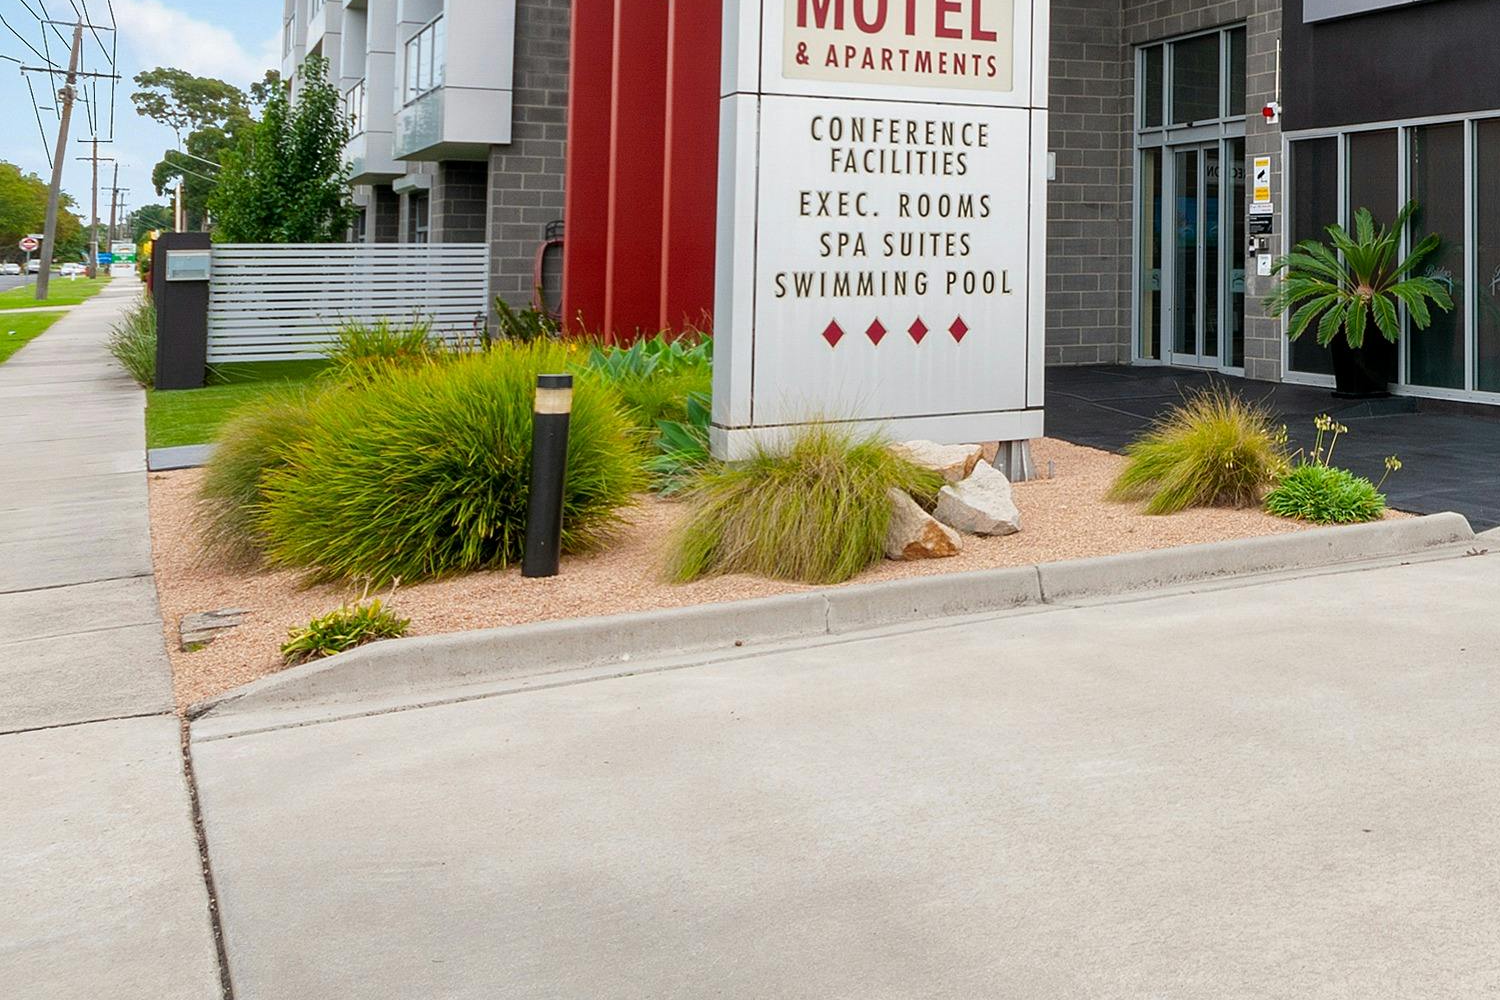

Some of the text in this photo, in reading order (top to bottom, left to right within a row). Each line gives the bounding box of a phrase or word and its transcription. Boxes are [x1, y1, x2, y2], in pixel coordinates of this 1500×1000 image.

[796, 41, 997, 78] & APARTMENTS
[811, 115, 989, 148] CONFERENCE
[830, 148, 968, 176] FACILITIES
[799, 191, 991, 218] EXEC. ROOMS
[820, 232, 970, 257] SPA SUITES
[775, 270, 1012, 298] SWIMMING POOL
